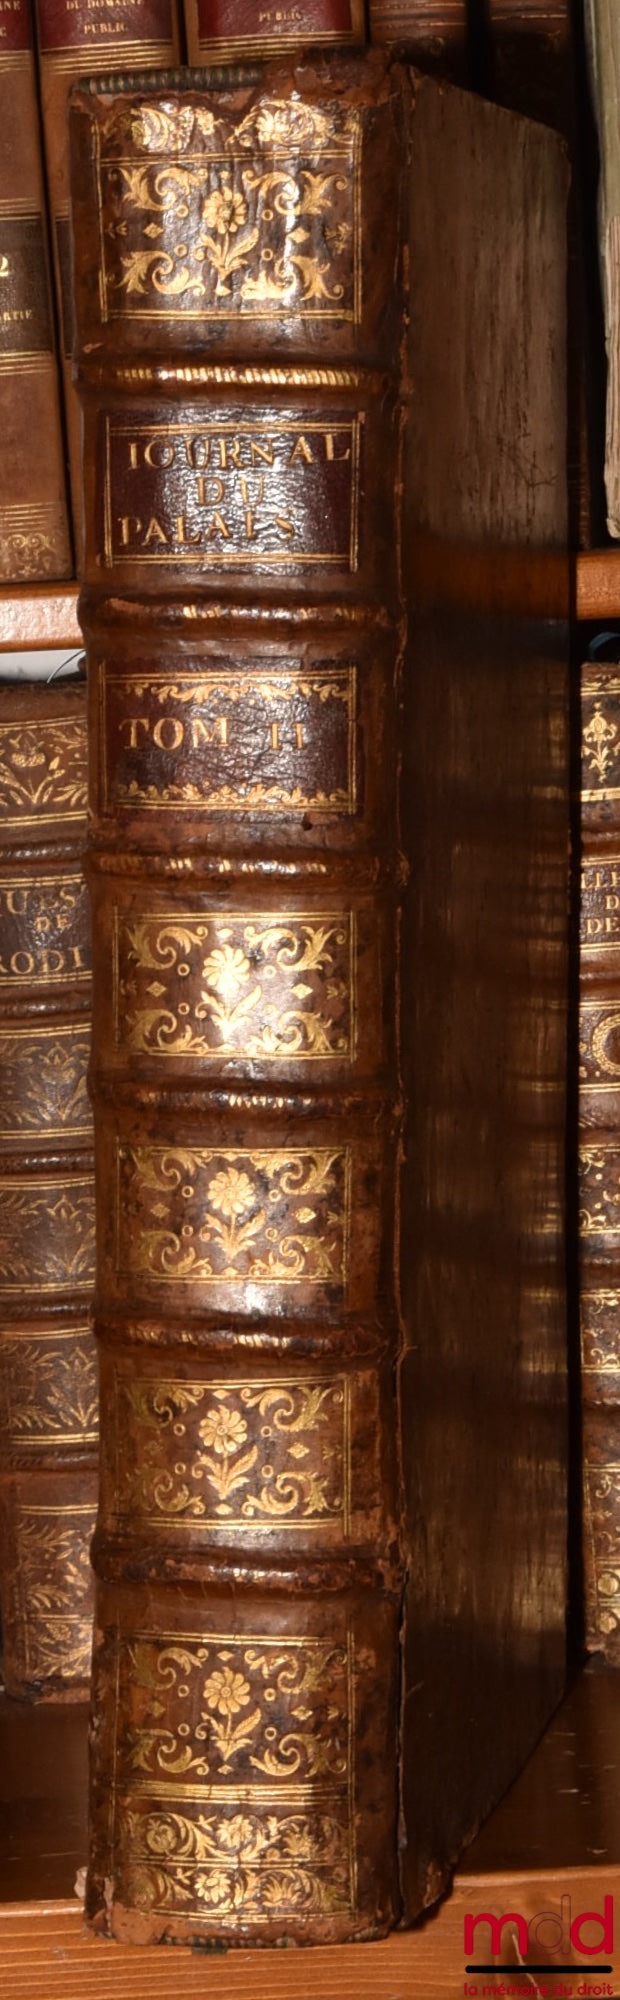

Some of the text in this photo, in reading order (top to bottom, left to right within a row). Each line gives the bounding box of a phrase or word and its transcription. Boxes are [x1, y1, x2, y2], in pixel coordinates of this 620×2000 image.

[83, 22, 128, 34] PUBLIC
[0, 309, 32, 321] RTIE
[195, 475, 265, 507] DU
[117, 510, 296, 547] PALAIS
[118, 716, 306, 751] TOM II
[35, 913, 73, 931] DE
